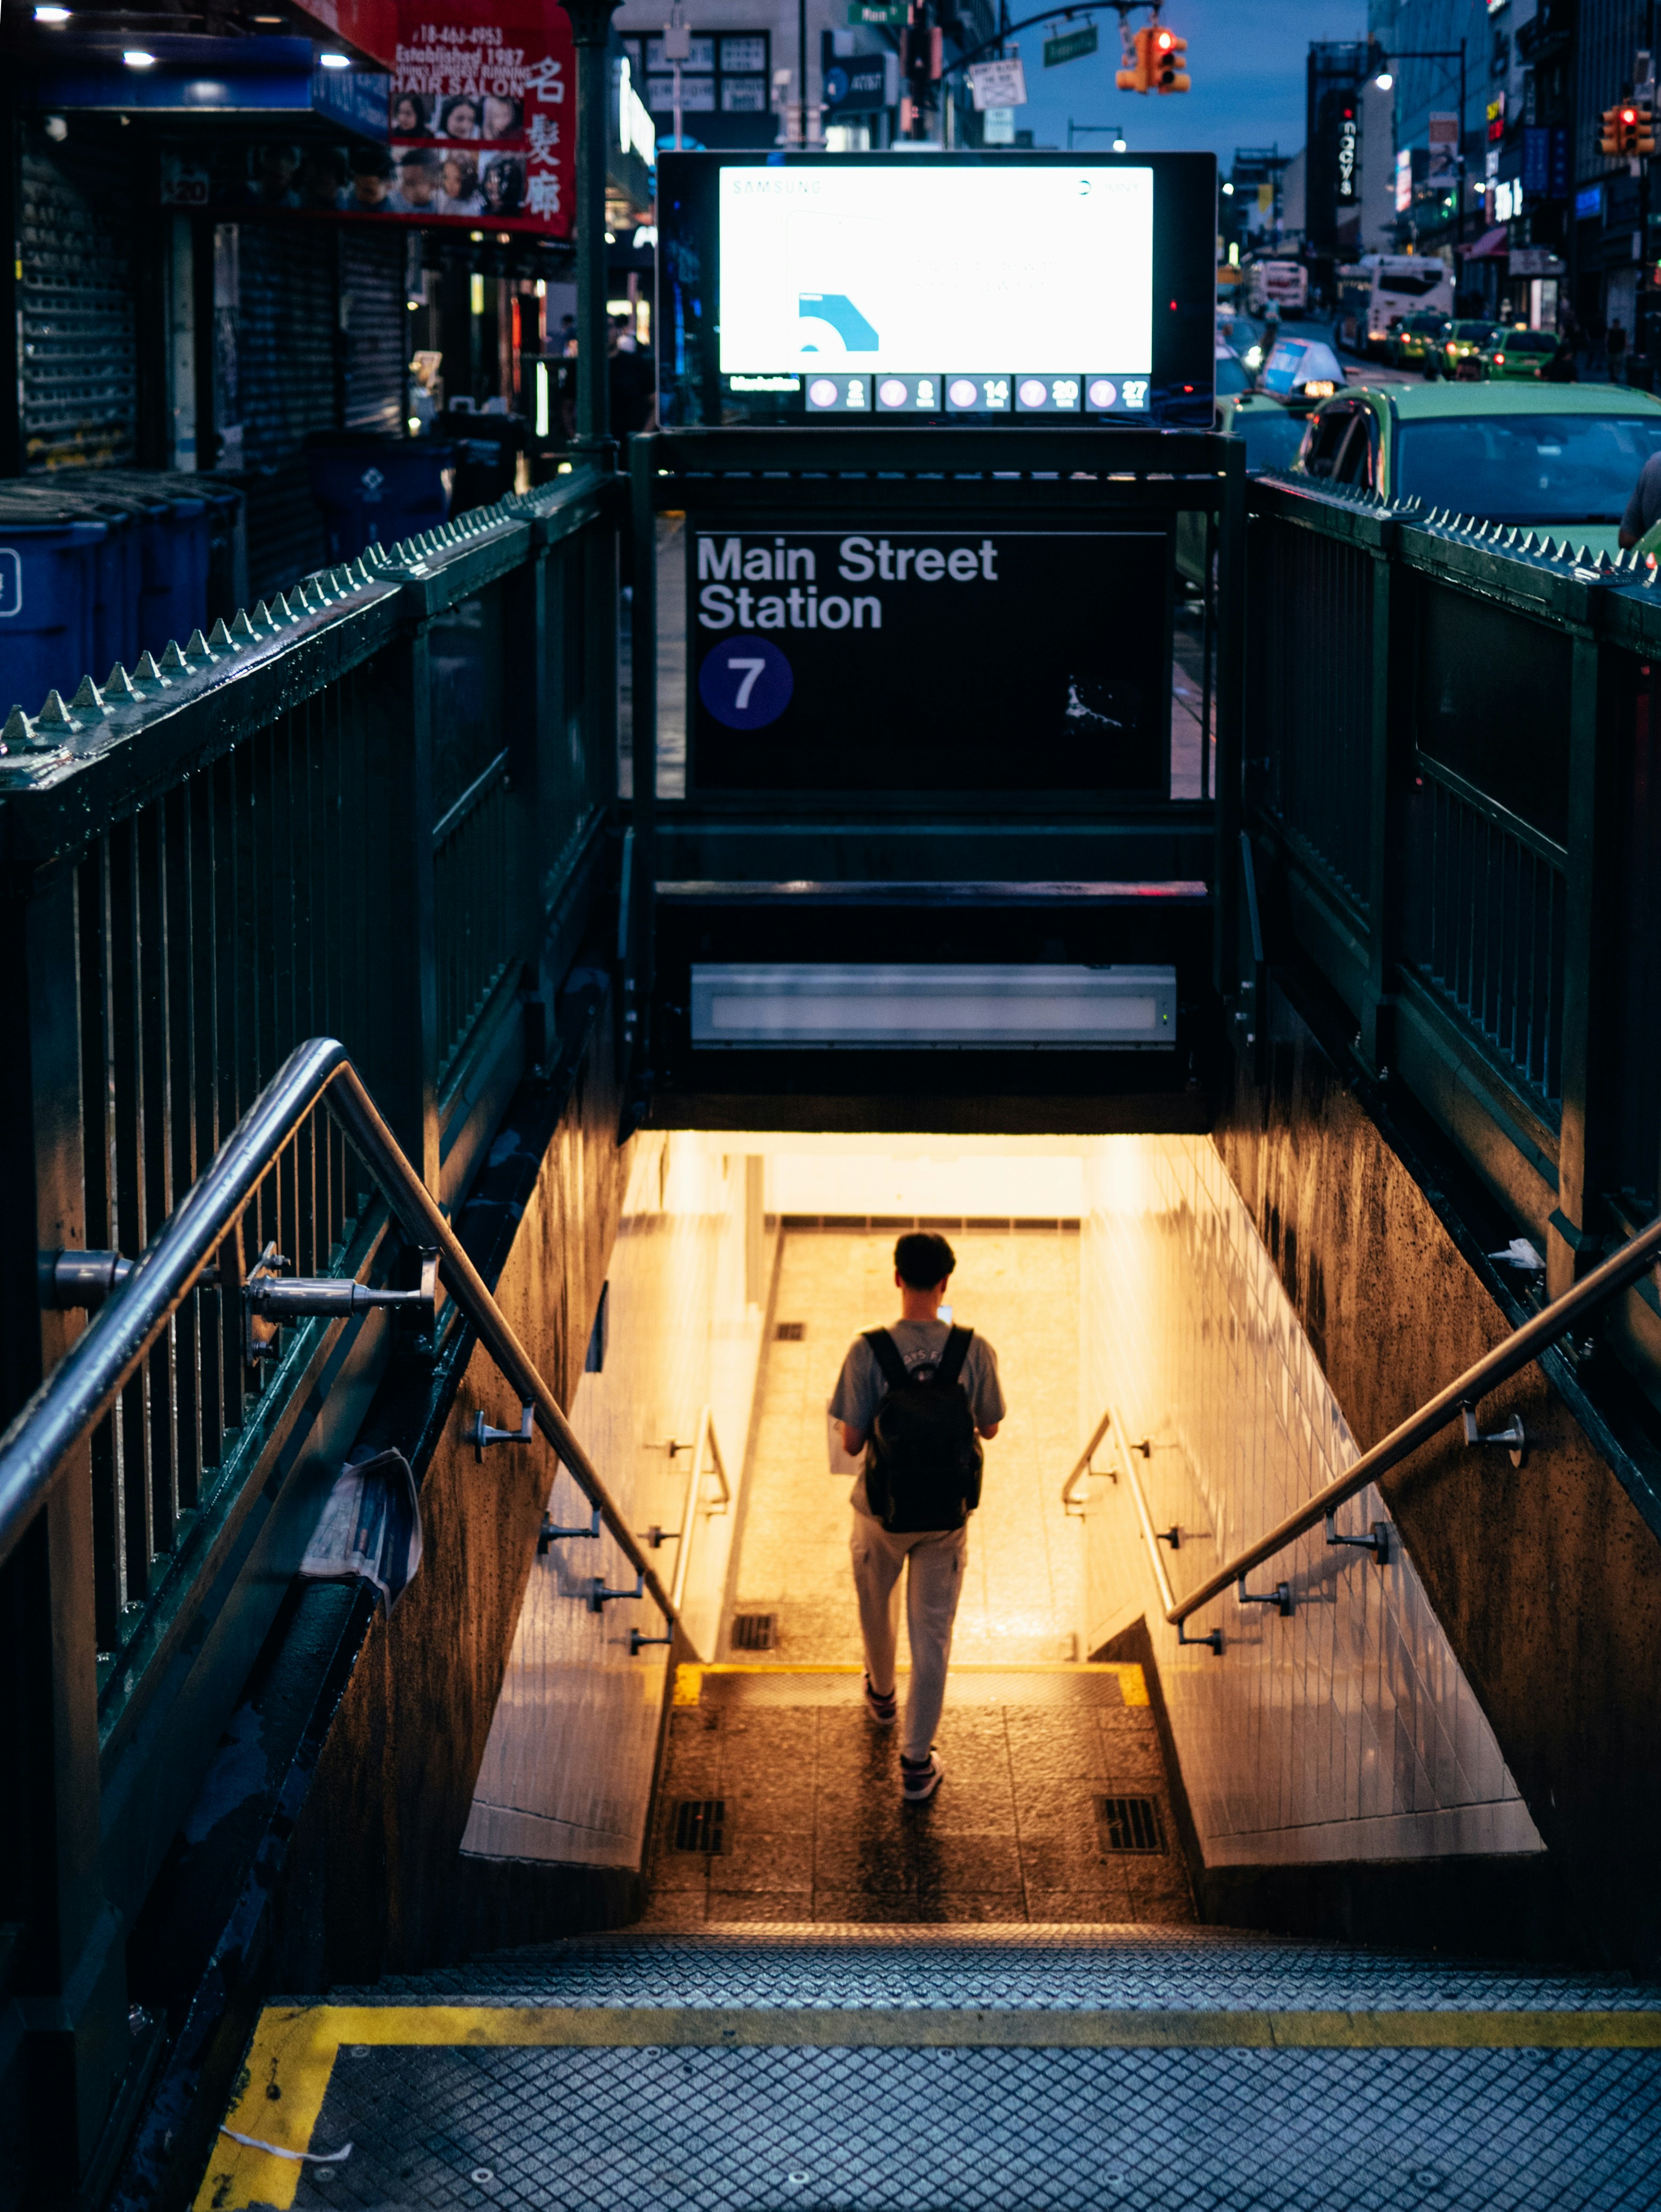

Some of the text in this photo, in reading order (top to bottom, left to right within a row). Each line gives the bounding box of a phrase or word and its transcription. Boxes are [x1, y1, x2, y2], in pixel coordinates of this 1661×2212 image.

[390, 75, 525, 97] HAIR SALON
[733, 180, 821, 193] SAMSUNG
[817, 384, 830, 401] 7
[848, 380, 863, 398] 2
[887, 384, 901, 401] 7
[918, 380, 933, 398] 8
[957, 384, 970, 402] 7
[983, 380, 1008, 399] 14
[1027, 385, 1040, 402] 7
[1052, 381, 1078, 399] 20
[1097, 385, 1110, 402] 7
[1122, 381, 1148, 399] 27
[697, 537, 998, 581] Main Street
[698, 584, 882, 629] Station
[727, 658, 766, 709] 7
